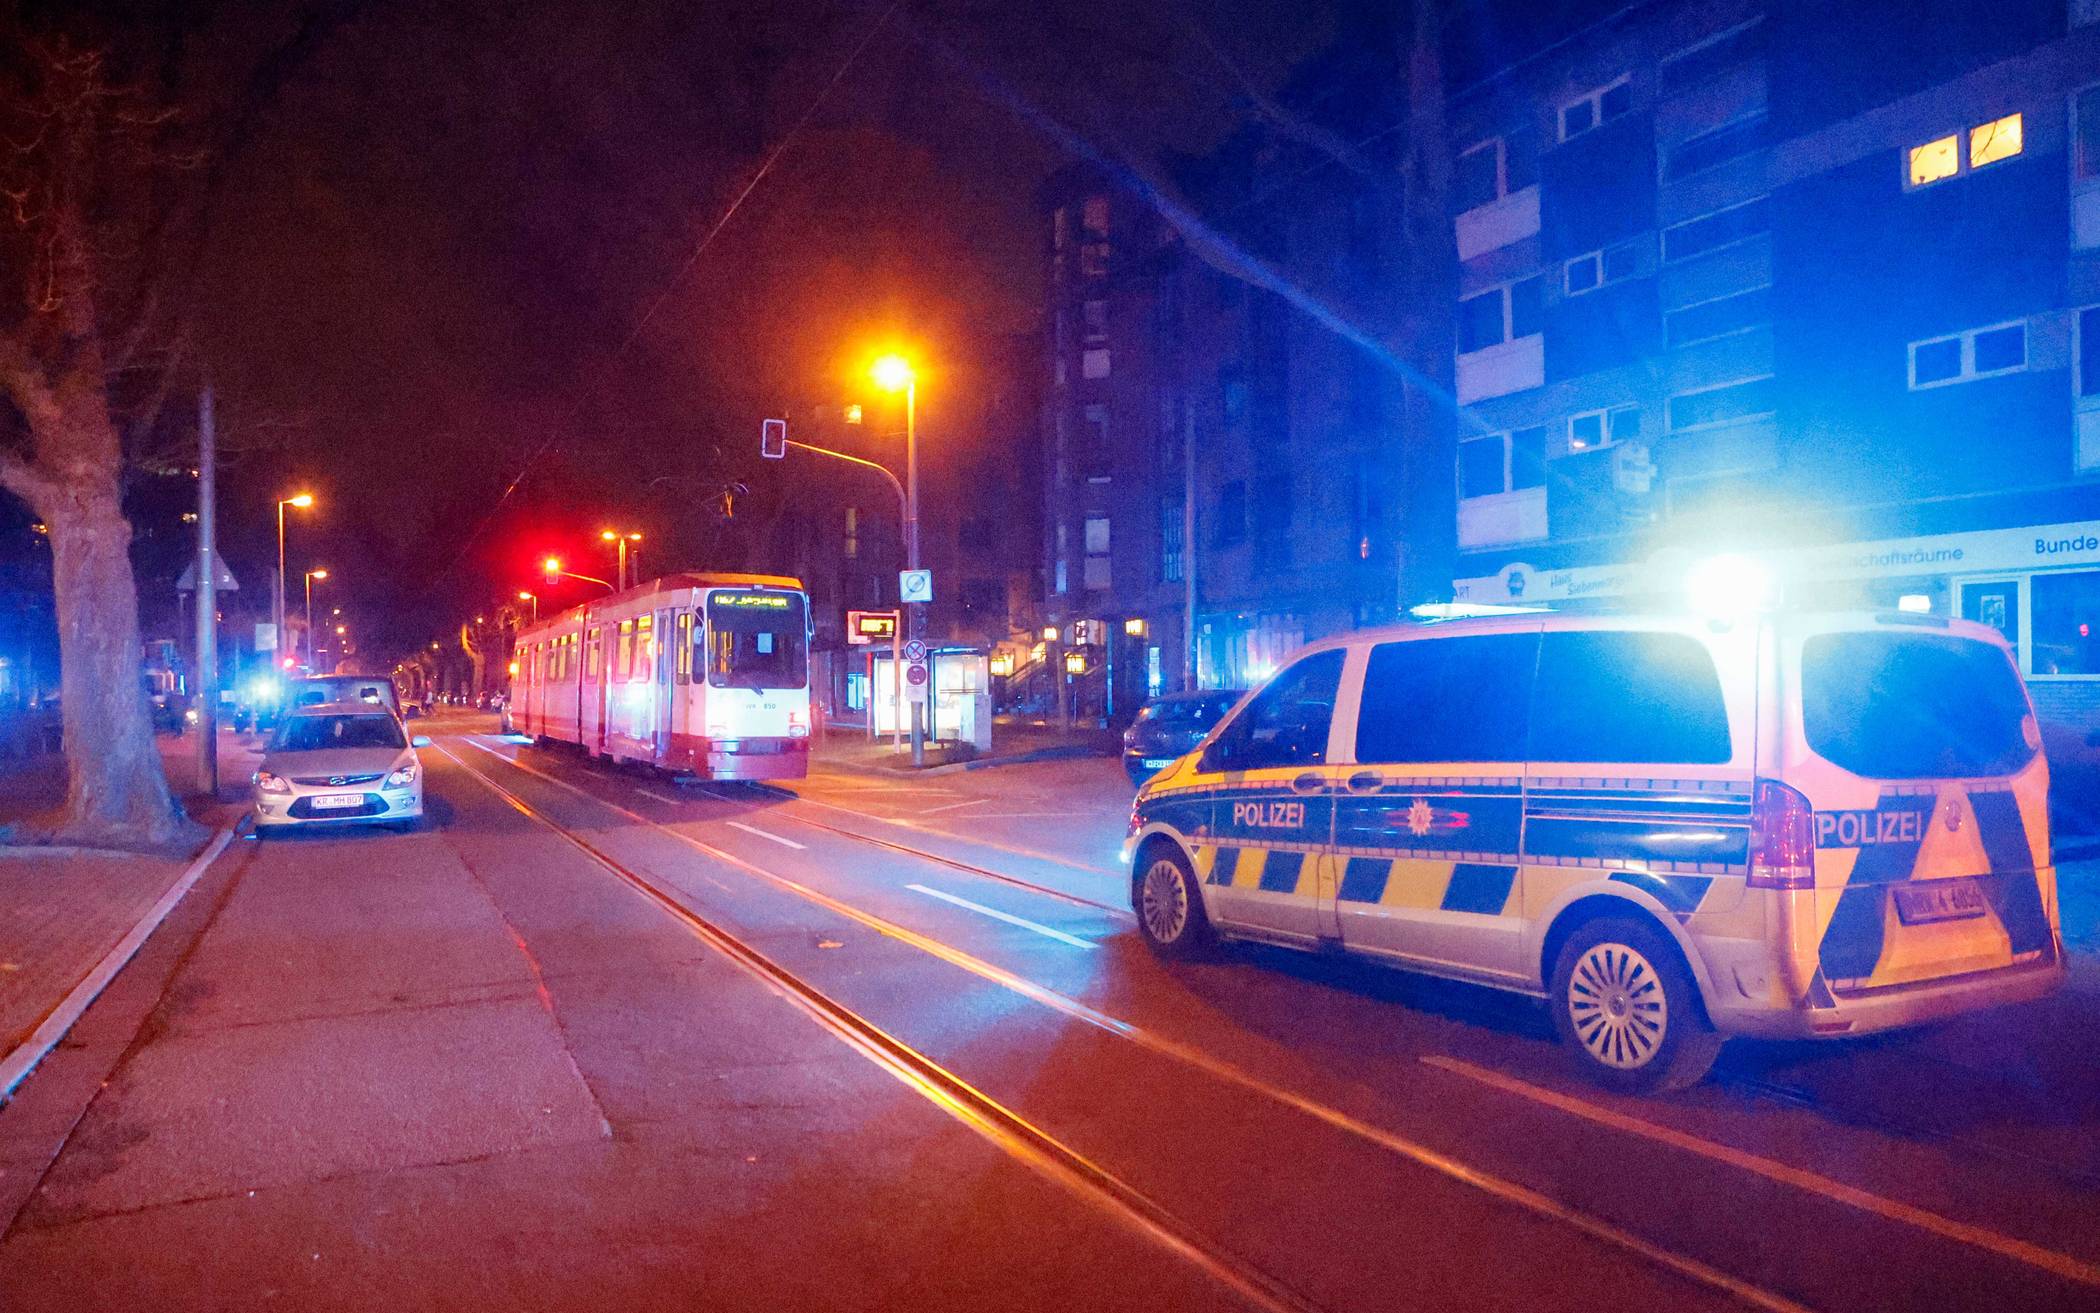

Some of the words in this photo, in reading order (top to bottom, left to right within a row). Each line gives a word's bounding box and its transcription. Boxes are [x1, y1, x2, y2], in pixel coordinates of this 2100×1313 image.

[2035, 534, 2099, 554] Bunde
[1234, 802, 1305, 828] POLIZEI
[1817, 811, 1922, 846] POLIZEI
